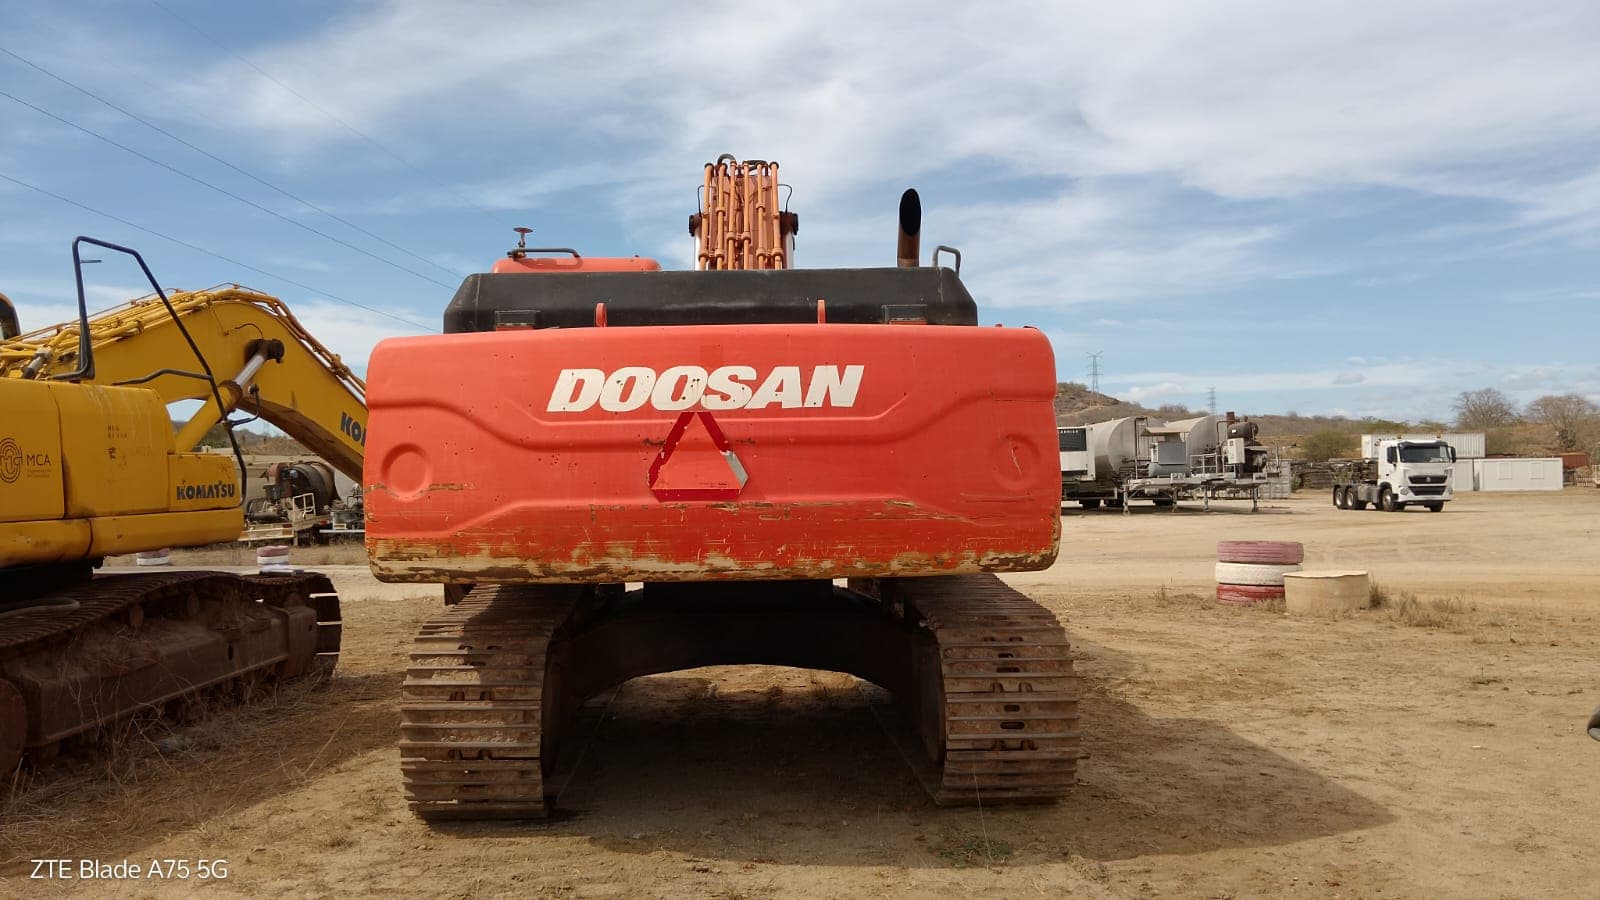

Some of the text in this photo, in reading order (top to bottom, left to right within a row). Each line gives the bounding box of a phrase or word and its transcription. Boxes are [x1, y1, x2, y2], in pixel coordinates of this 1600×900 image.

[546, 365, 865, 413] DOOSAN
[26, 453, 51, 466] MCA
[176, 484, 235, 500] KOMATSU
